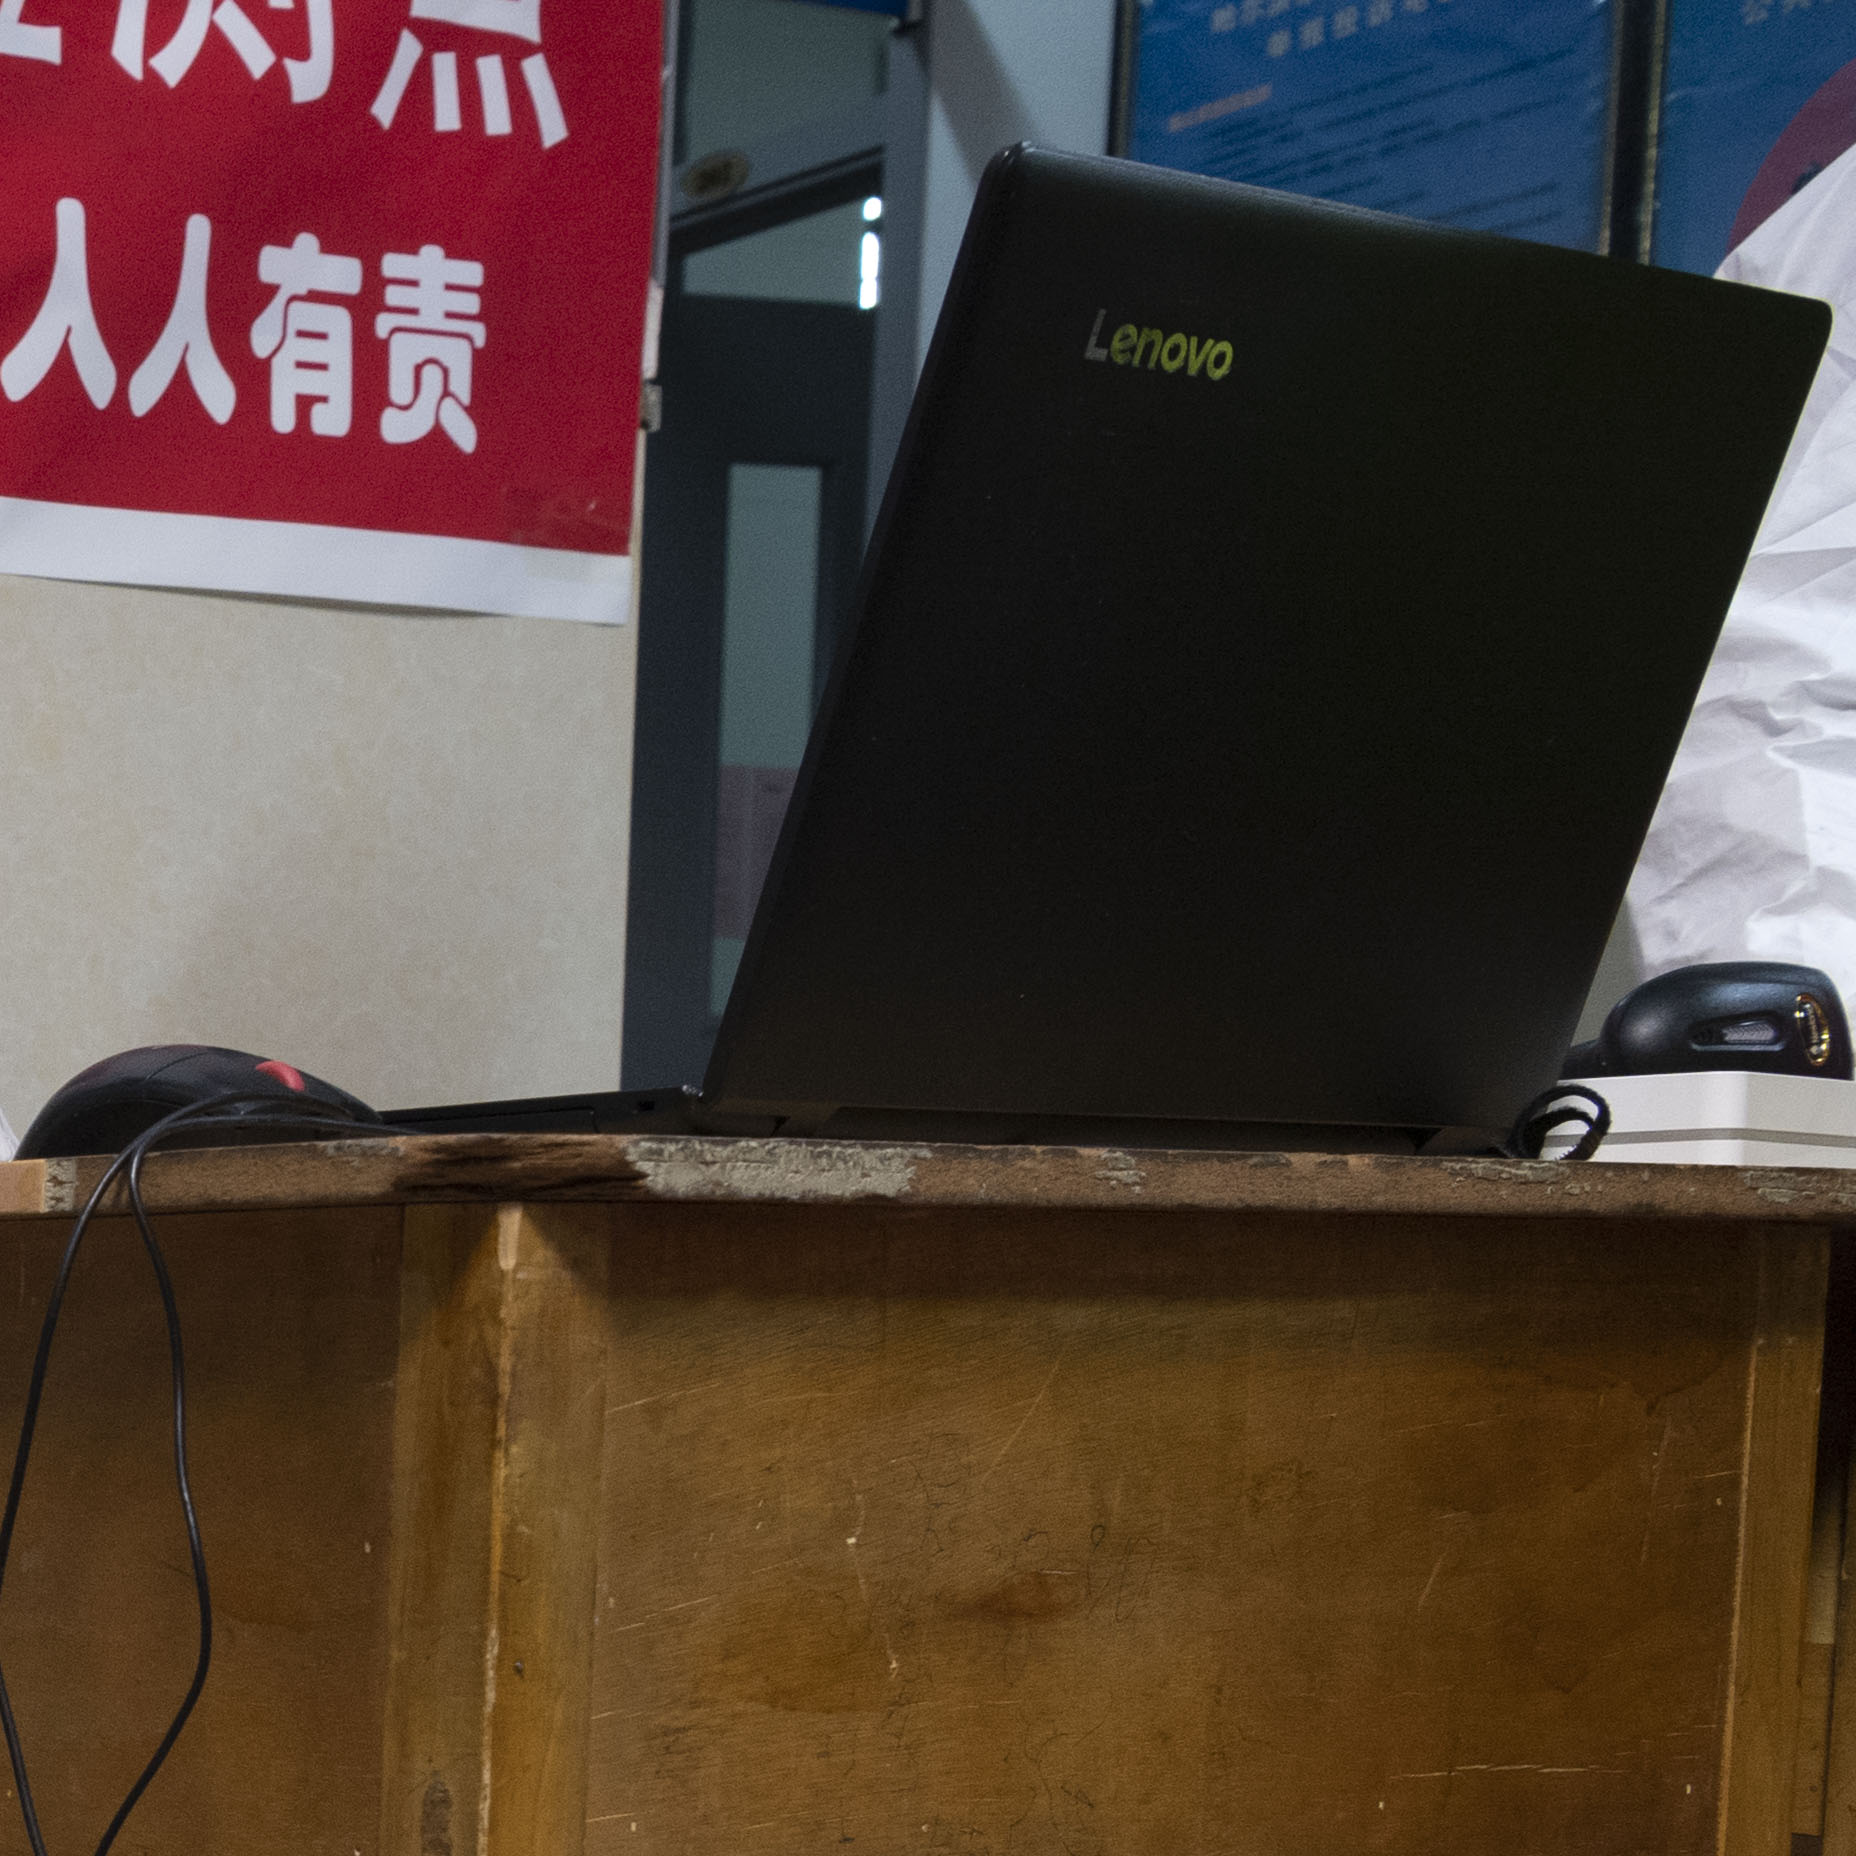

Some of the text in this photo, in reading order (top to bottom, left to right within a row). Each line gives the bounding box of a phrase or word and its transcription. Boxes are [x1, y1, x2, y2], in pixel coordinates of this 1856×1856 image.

[0, 197, 487, 453] 人人有责
[1086, 308, 1234, 381] Lenovo
